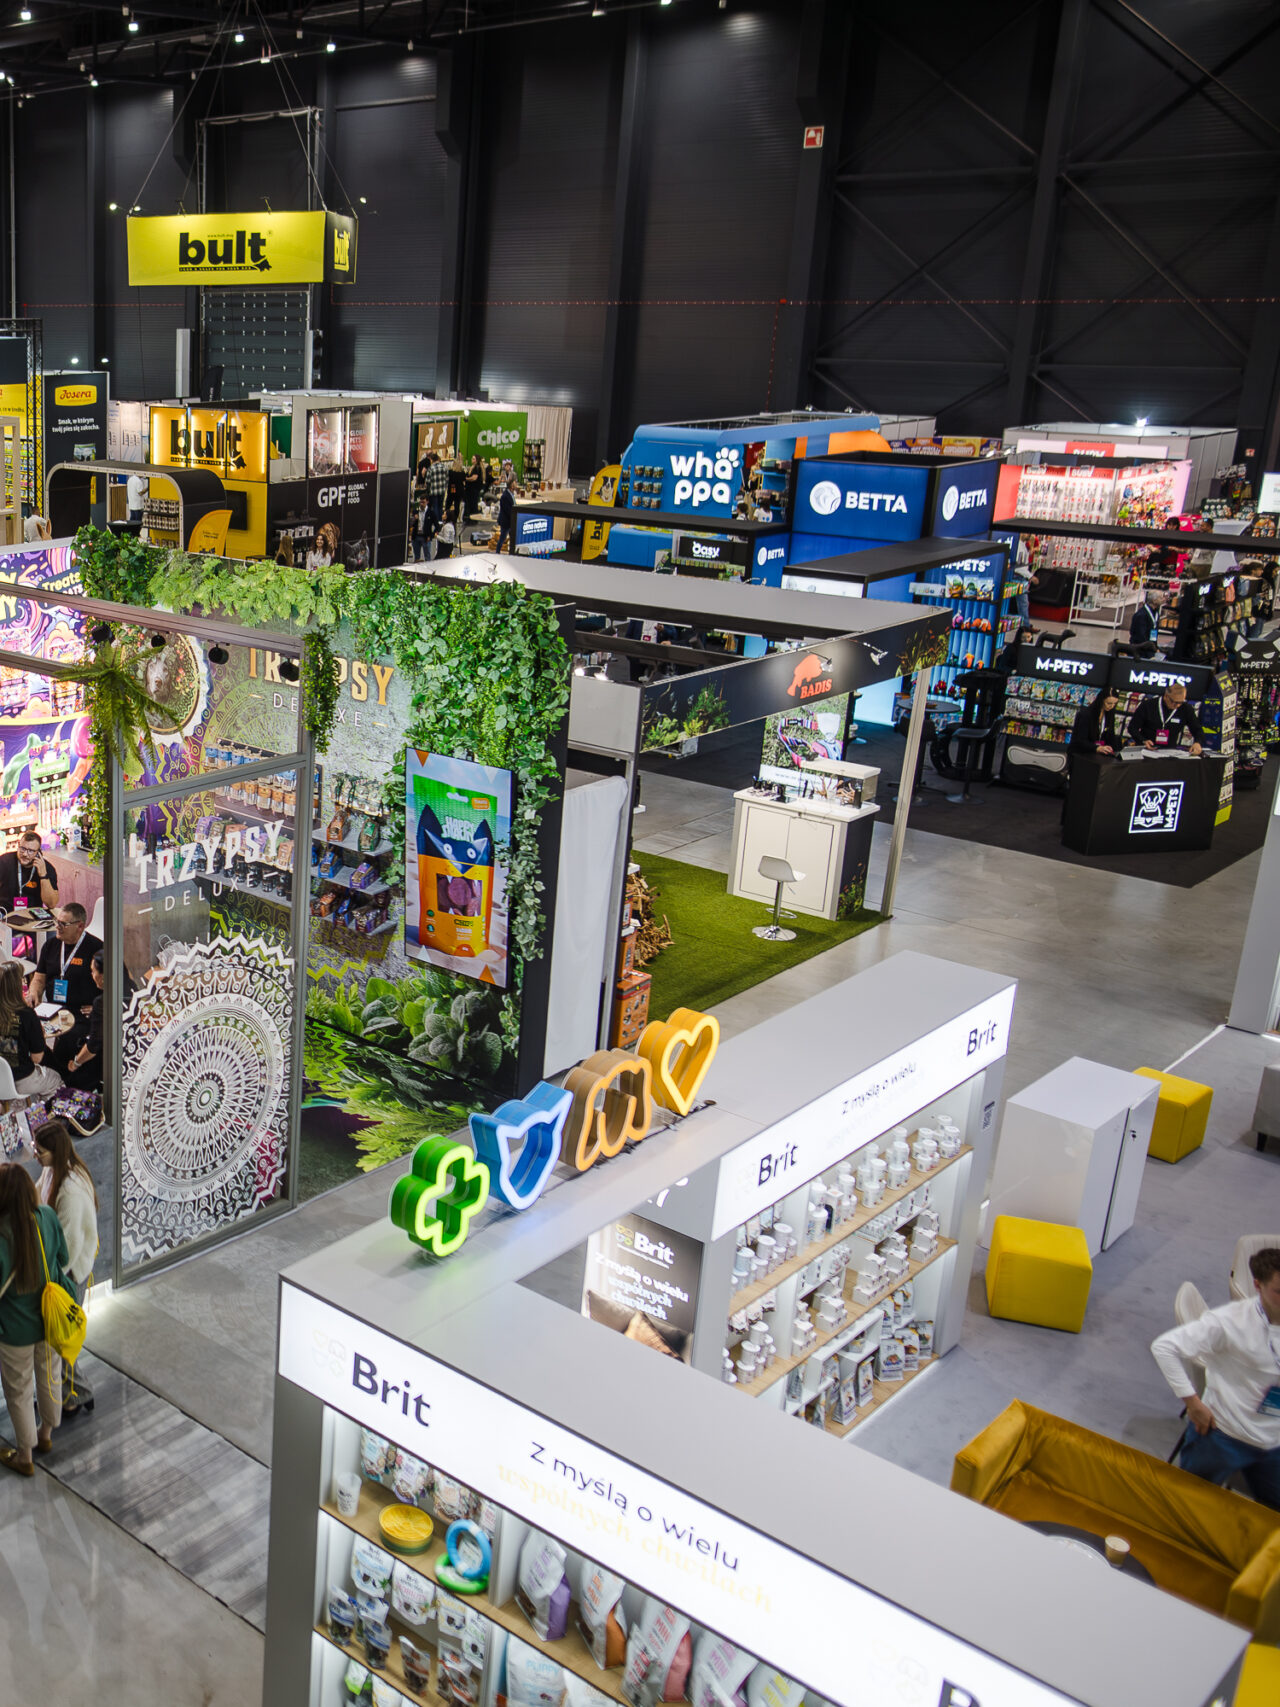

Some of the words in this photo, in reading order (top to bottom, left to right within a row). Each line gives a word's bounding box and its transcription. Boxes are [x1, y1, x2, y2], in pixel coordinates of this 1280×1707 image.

[179, 231, 267, 265] bult
[60, 389, 92, 400] Josera
[171, 419, 241, 458] bult
[317, 485, 346, 508] GPF
[348, 483, 365, 491] GLOBAL
[674, 480, 731, 507] ppa
[958, 489, 987, 511] BETTA
[844, 491, 907, 514] BETTA
[768, 547, 785, 560] BETTA
[1036, 657, 1089, 676] M-PETS
[1240, 661, 1270, 669] M-PETS
[800, 678, 832, 699] BADIS
[1129, 670, 1186, 688] M-PETS
[273, 692, 363, 727] DEXE
[1164, 788, 1179, 828] M-PETS
[135, 820, 284, 896] TRZYPSY
[164, 873, 256, 911] DELUXE
[967, 1020, 998, 1057] Brit
[758, 1143, 798, 1186] Brit
[634, 1231, 675, 1264] Brit
[642, 1275, 652, 1286] o
[653, 1278, 689, 1302] wielu
[352, 1351, 431, 1428] Brit
[530, 1441, 548, 1464] Z
[552, 1460, 628, 1516] myślą
[637, 1504, 653, 1524] o
[661, 1515, 740, 1571] wielu
[526, 1659, 560, 1676] PUPPY
